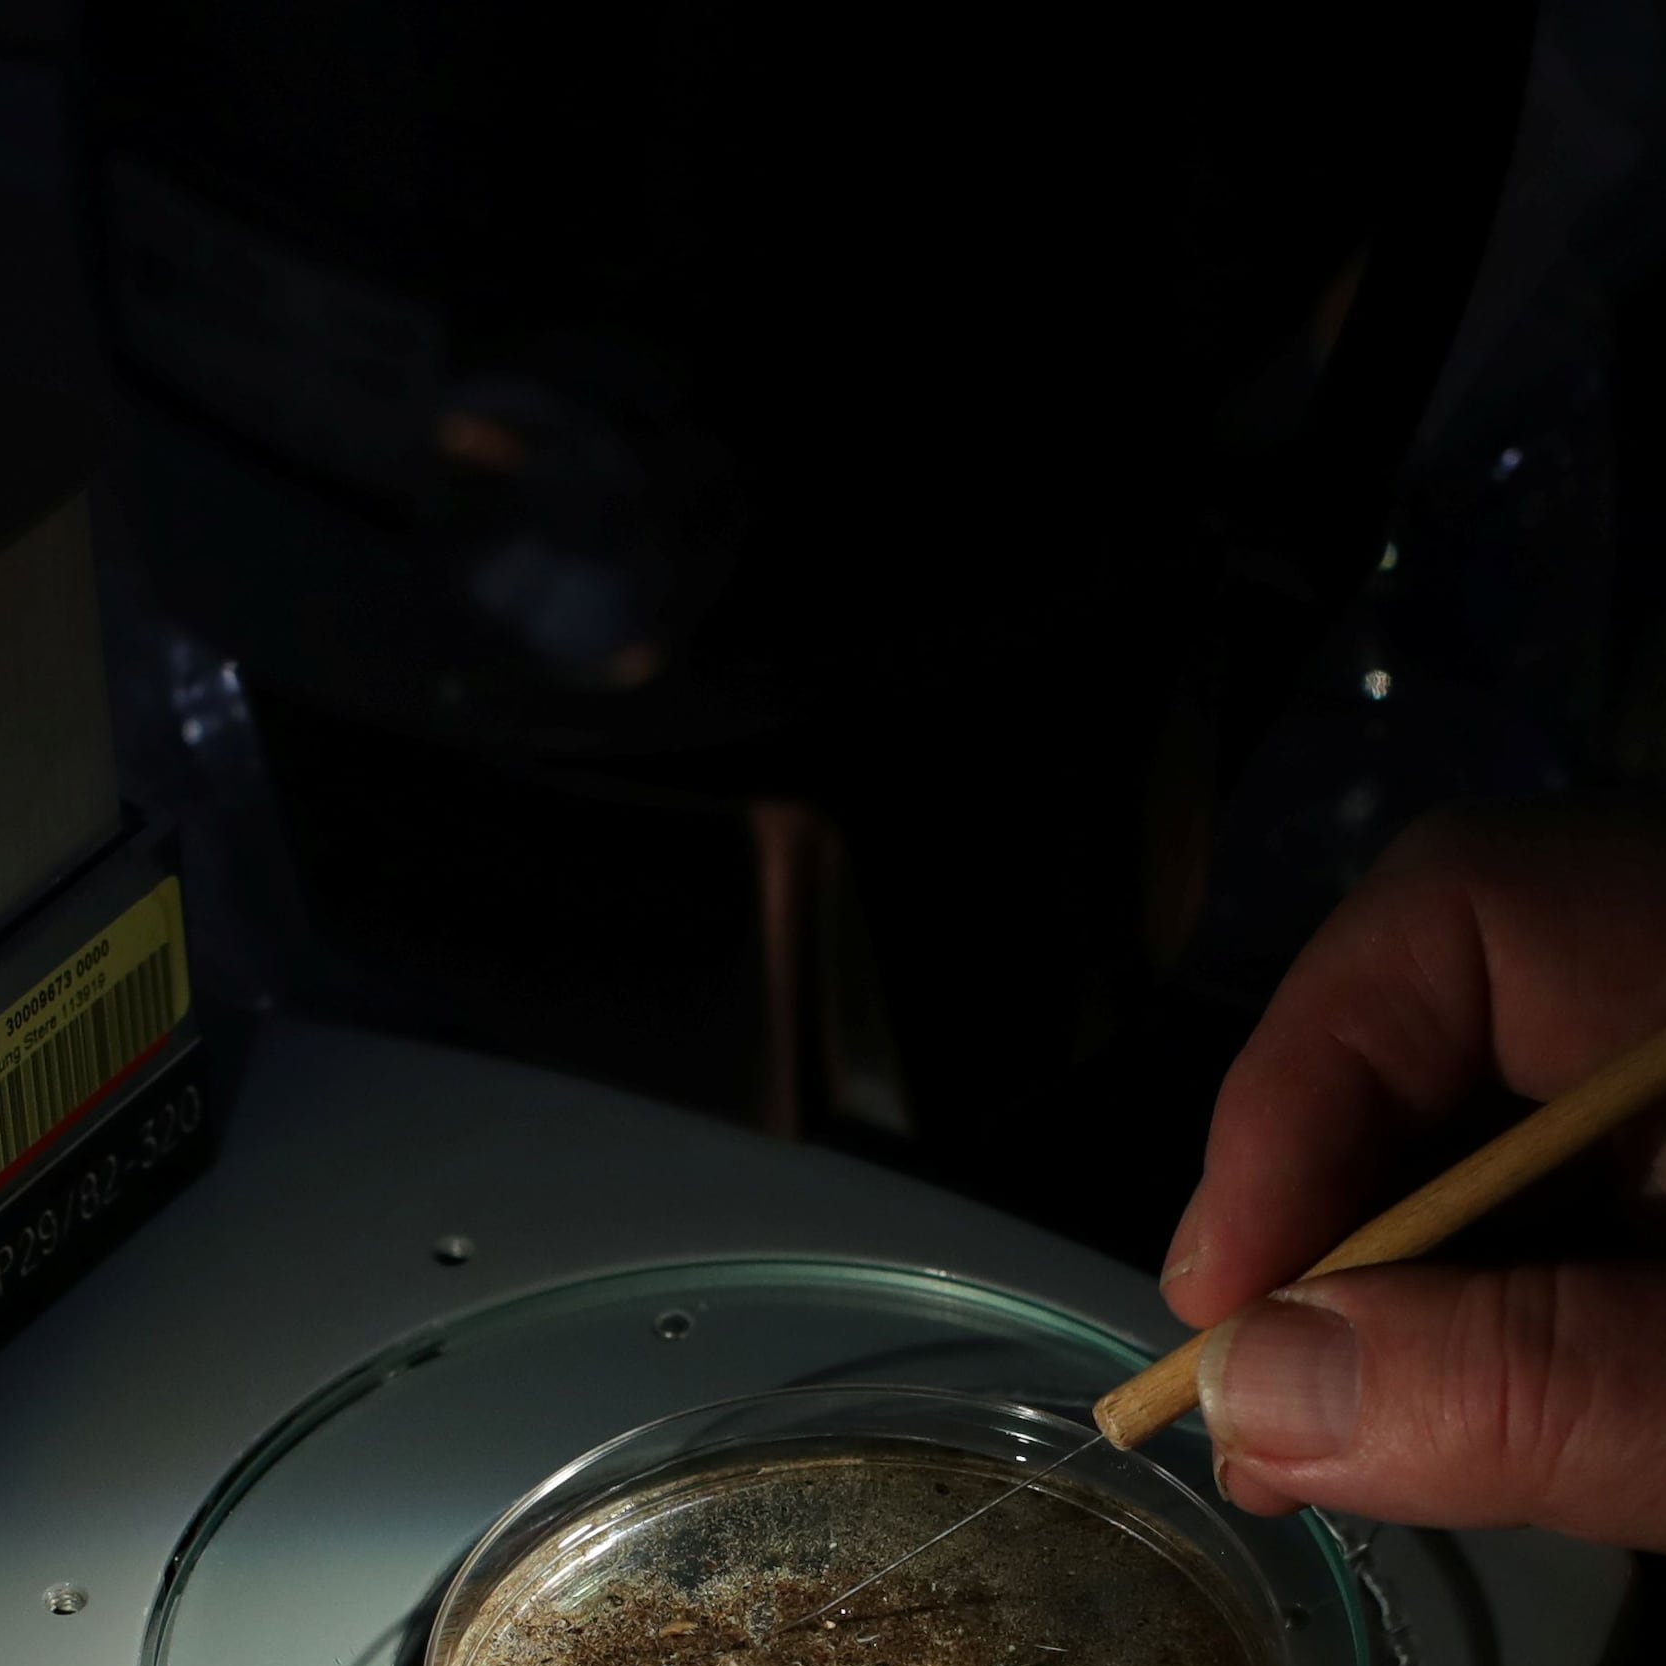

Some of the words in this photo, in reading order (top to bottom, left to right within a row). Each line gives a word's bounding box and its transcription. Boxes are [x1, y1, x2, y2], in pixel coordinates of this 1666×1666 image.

[5, 969, 72, 1037] 30009673
[76, 939, 110, 977] 0000
[23, 1015, 57, 1050] Stere
